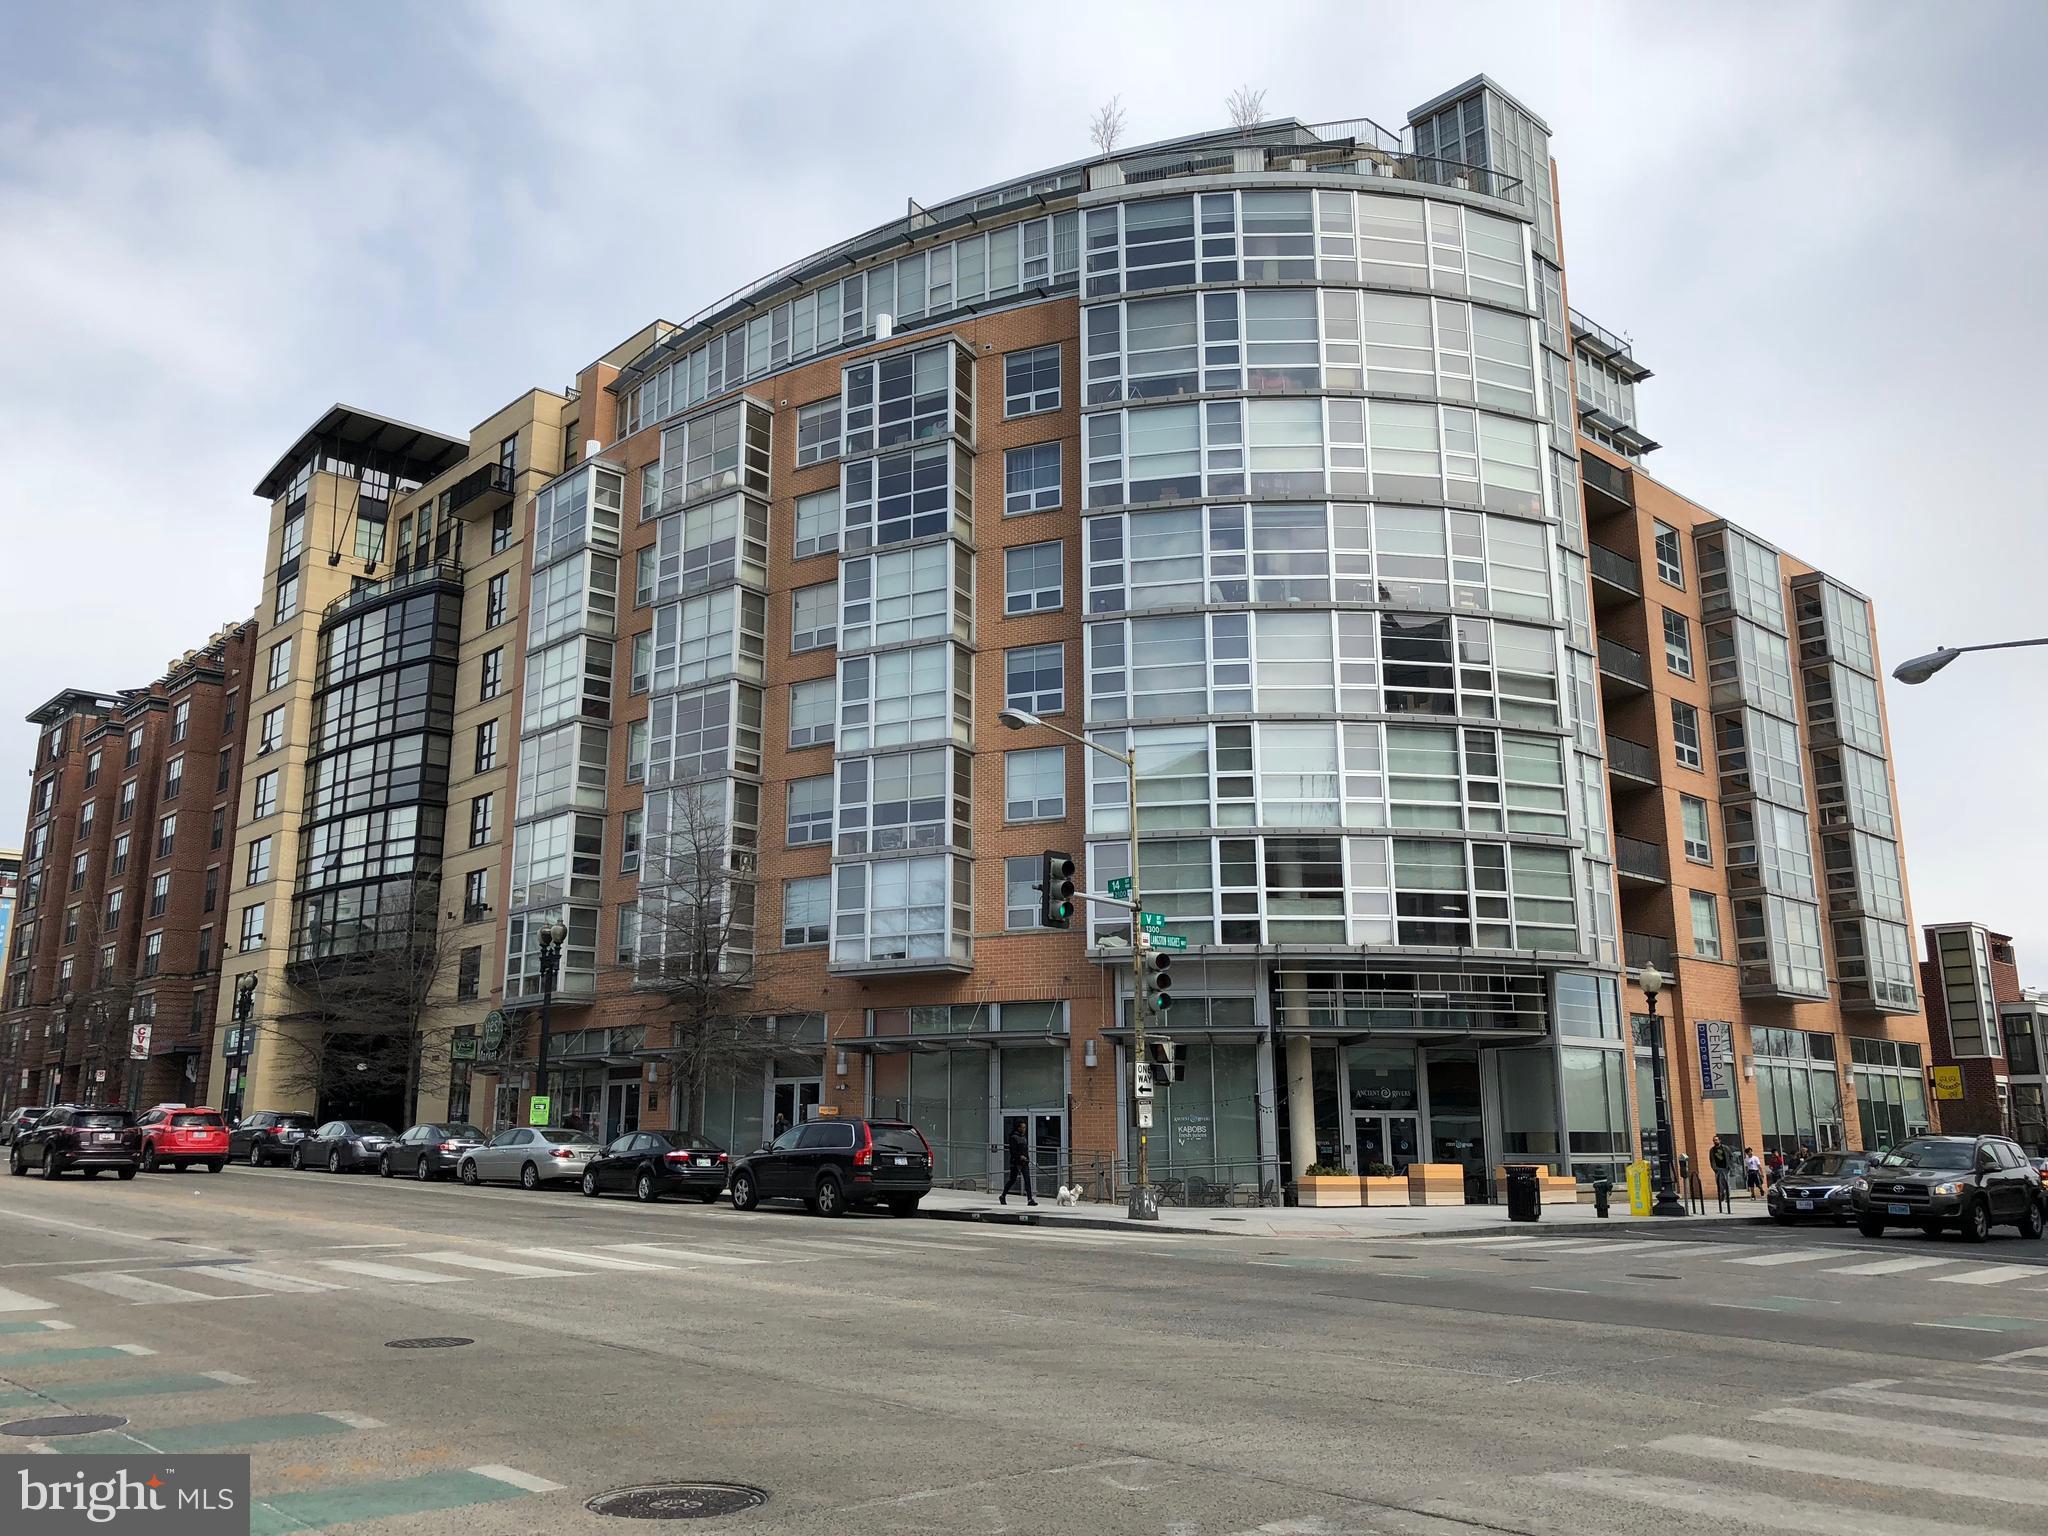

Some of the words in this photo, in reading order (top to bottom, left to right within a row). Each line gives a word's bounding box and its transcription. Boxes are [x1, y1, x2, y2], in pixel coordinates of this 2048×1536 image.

[1112, 880, 1120, 890] 14
[1114, 891, 1127, 899] 2100
[1146, 914, 1152, 924] V
[1146, 925, 1160, 934] 1300
[1698, 1025, 1711, 1089] properties
[1708, 1022, 1725, 1089] CENTRAL
[1137, 1064, 1152, 1074] ONE
[1138, 1075, 1152, 1083] WAY
[1356, 1089, 1380, 1098] ANCIENT
[1391, 1090, 1411, 1098] RIVERS
